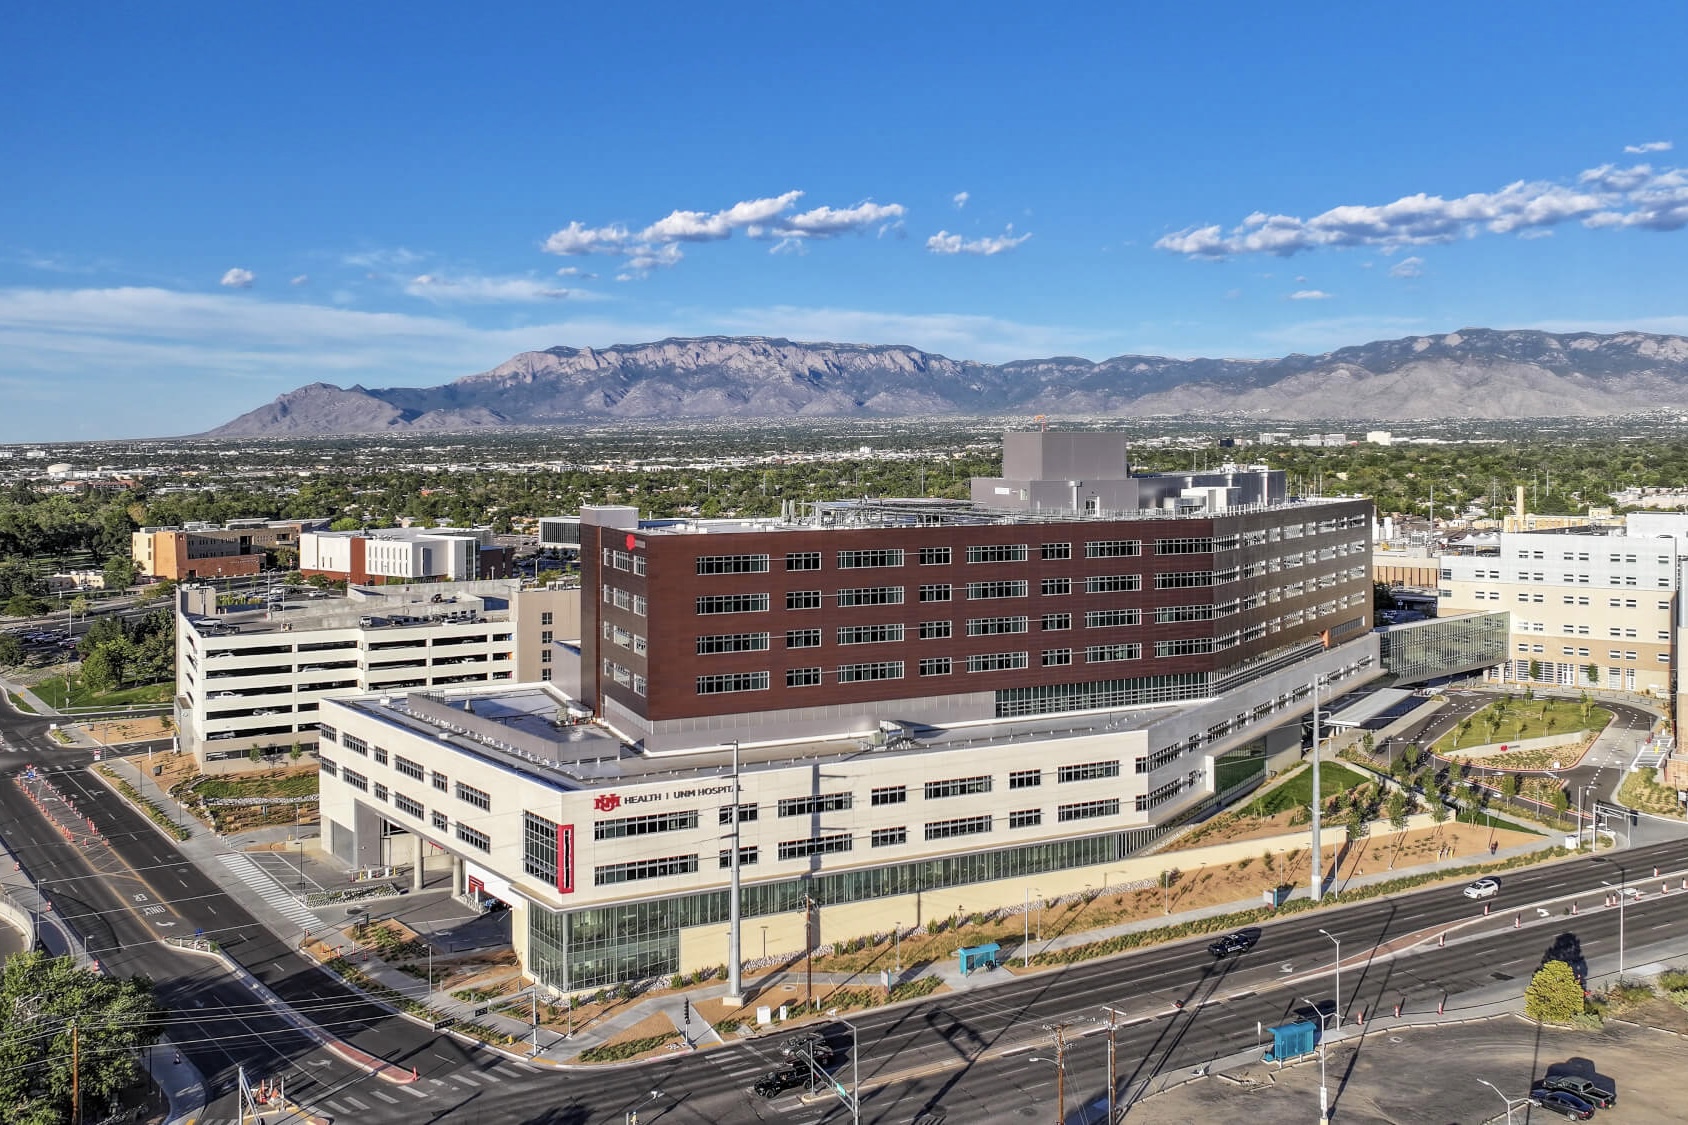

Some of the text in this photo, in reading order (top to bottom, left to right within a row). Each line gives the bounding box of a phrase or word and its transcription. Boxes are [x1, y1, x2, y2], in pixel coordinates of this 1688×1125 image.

[624, 792, 662, 804] HEALTH
[674, 790, 696, 799] UNM
[143, 906, 165, 916] ONLY
